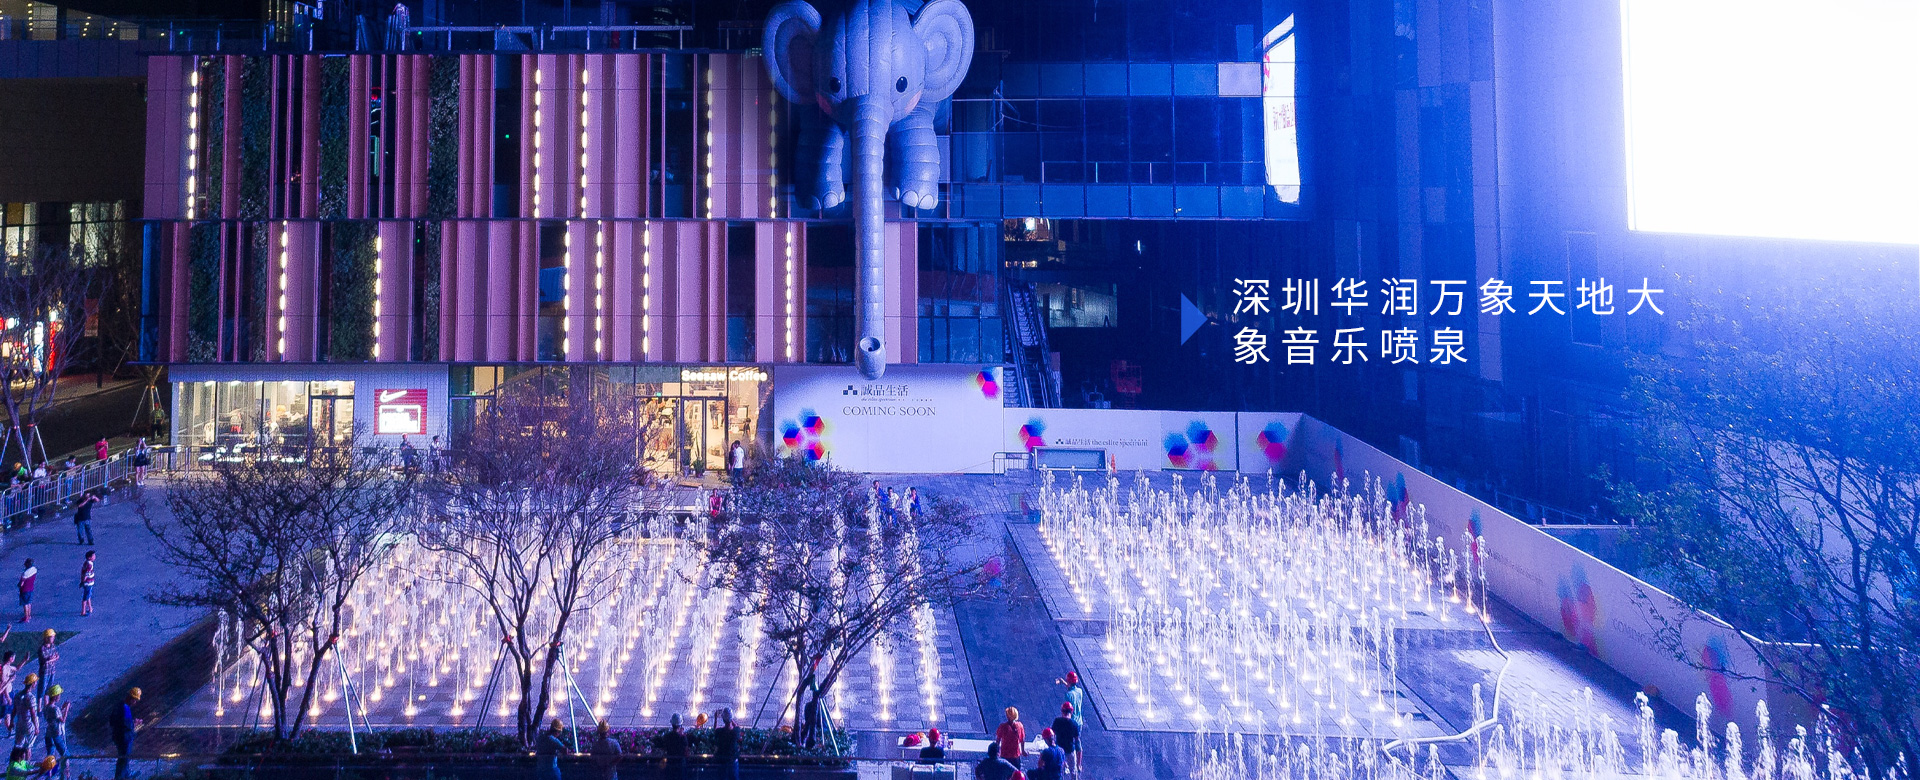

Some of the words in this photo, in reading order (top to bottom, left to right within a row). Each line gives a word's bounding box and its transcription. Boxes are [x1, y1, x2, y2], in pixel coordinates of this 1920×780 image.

[681, 370, 727, 382] Seesaw
[729, 370, 768, 382] Coffee
[860, 384, 909, 397] 誠品生活
[842, 406, 896, 416] COMING
[899, 406, 936, 416] SOON
